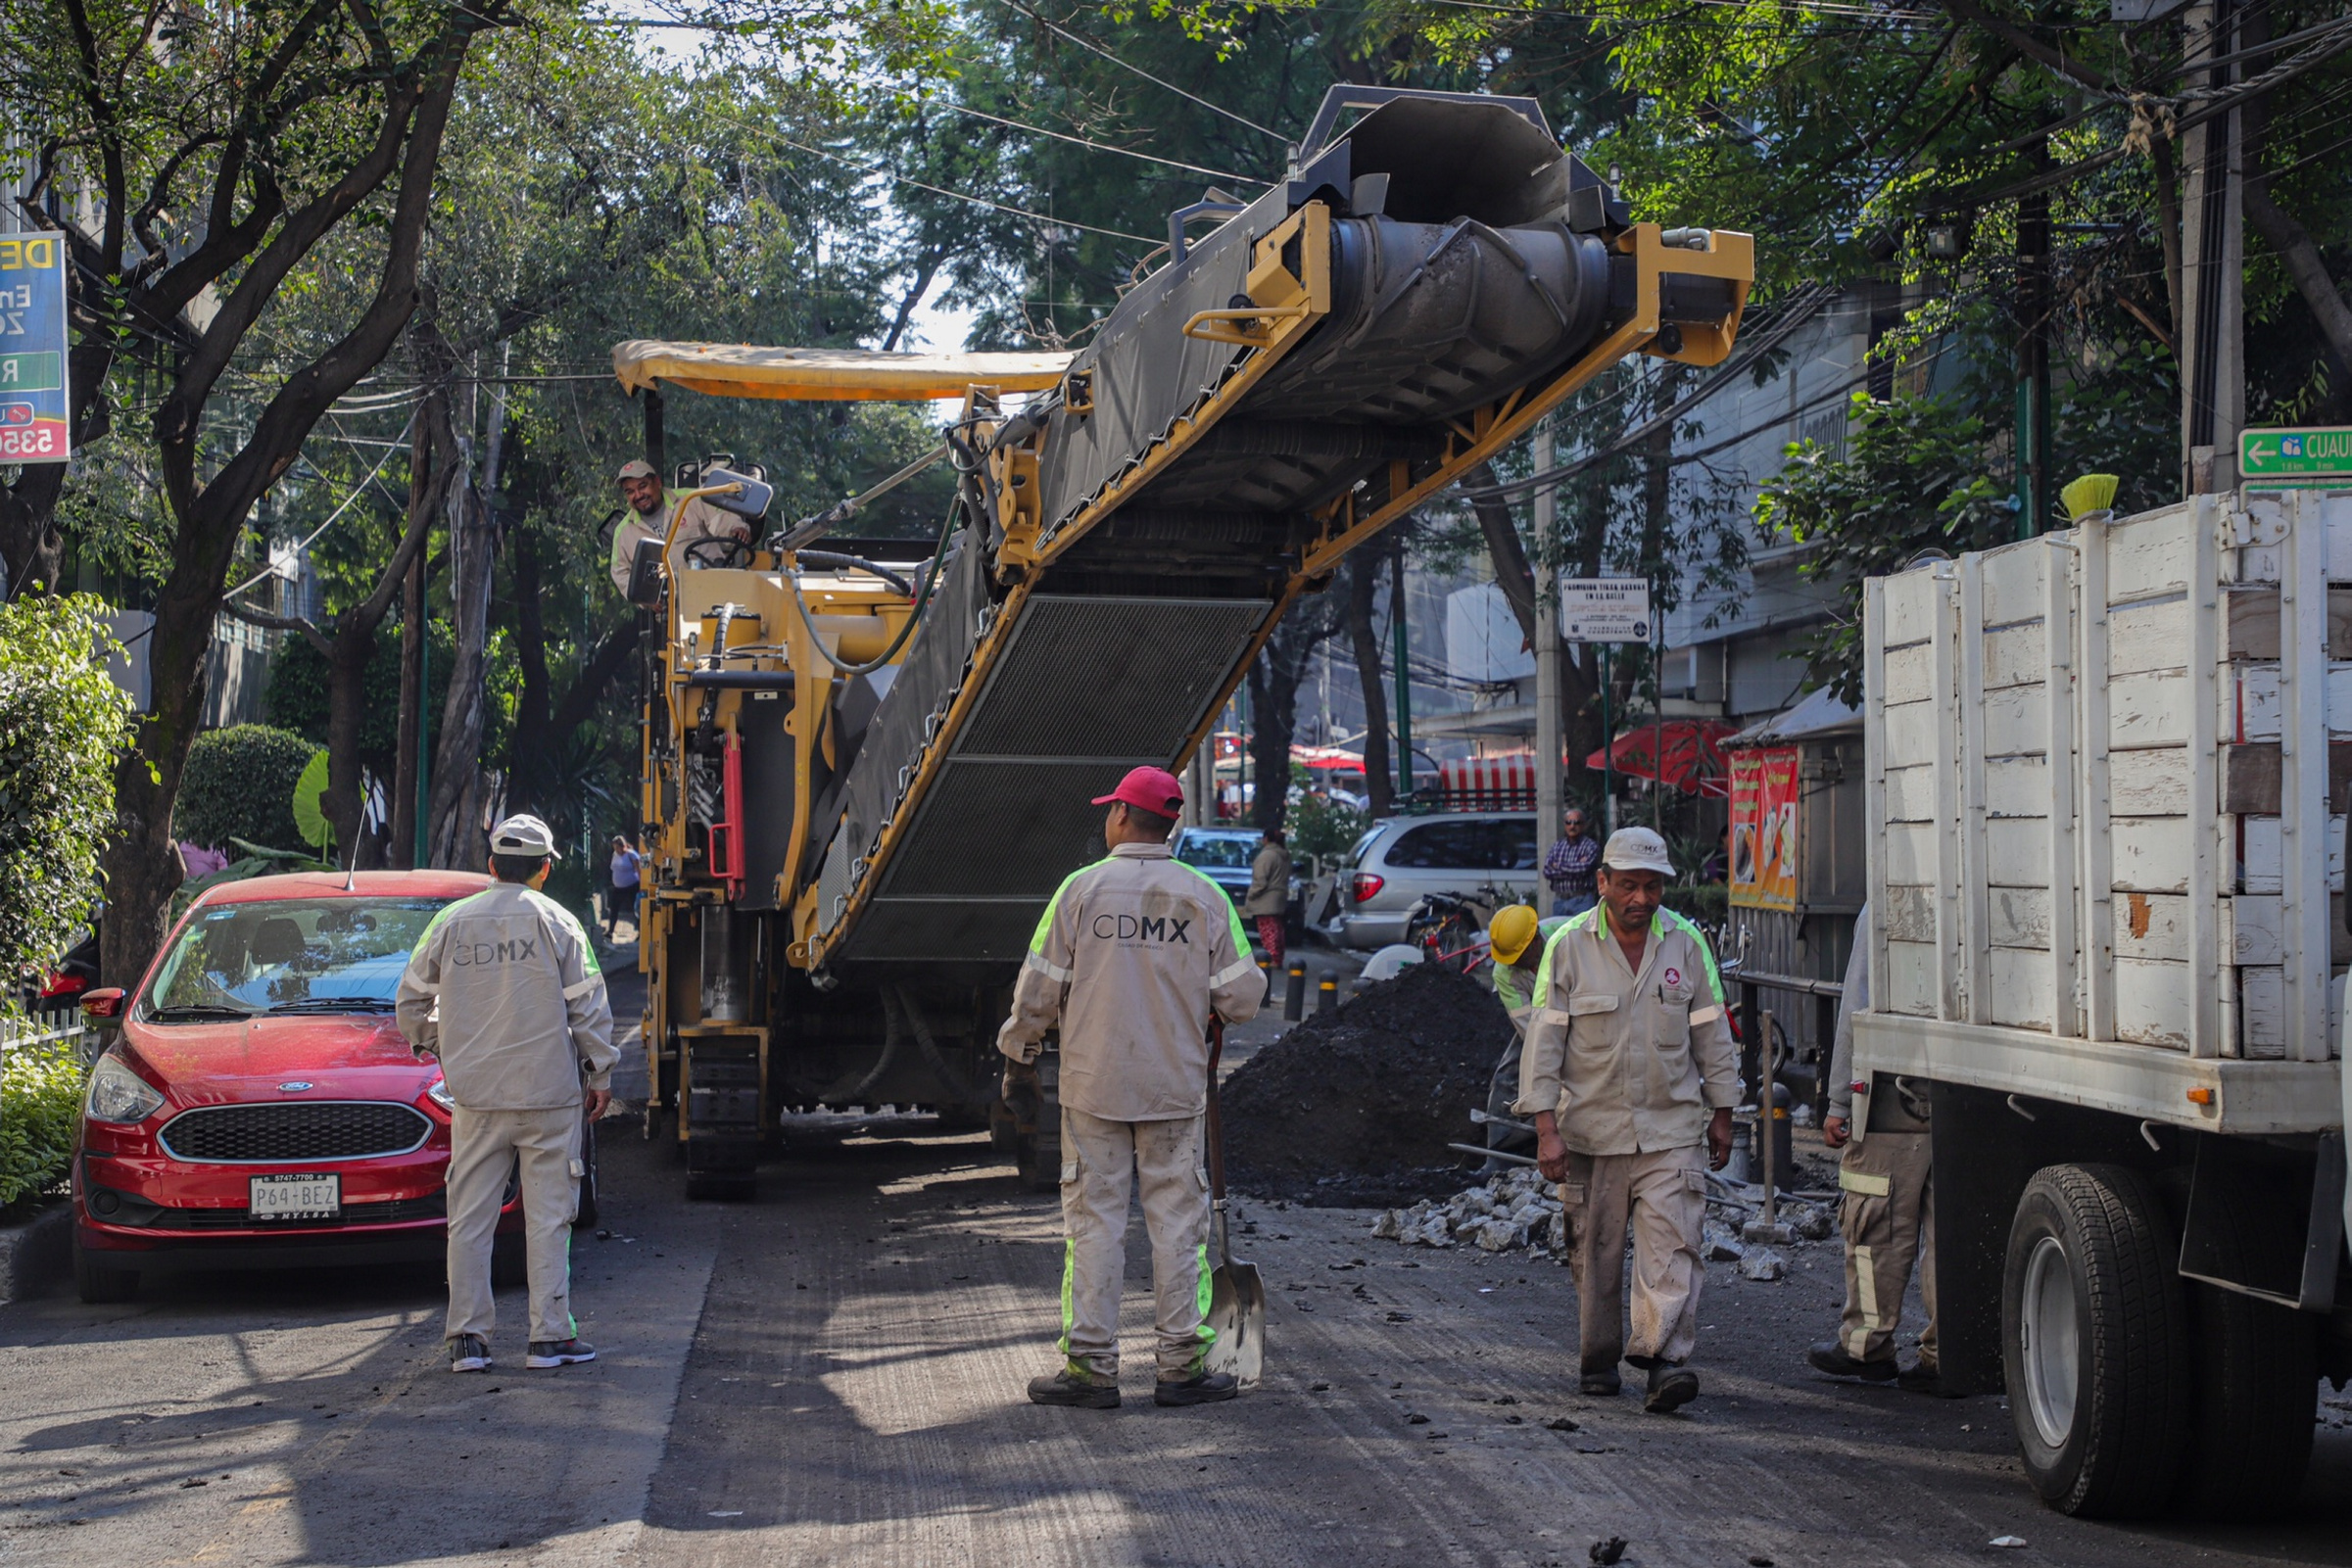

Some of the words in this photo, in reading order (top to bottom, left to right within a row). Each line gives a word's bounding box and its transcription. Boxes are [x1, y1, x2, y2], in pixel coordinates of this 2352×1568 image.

[2306, 434, 2352, 458] CUAU
[1630, 843, 1658, 853] CDMX
[1093, 915, 1191, 944] CDMX
[453, 938, 538, 967] CDMX
[257, 1185, 334, 1208] P64-BEZ
